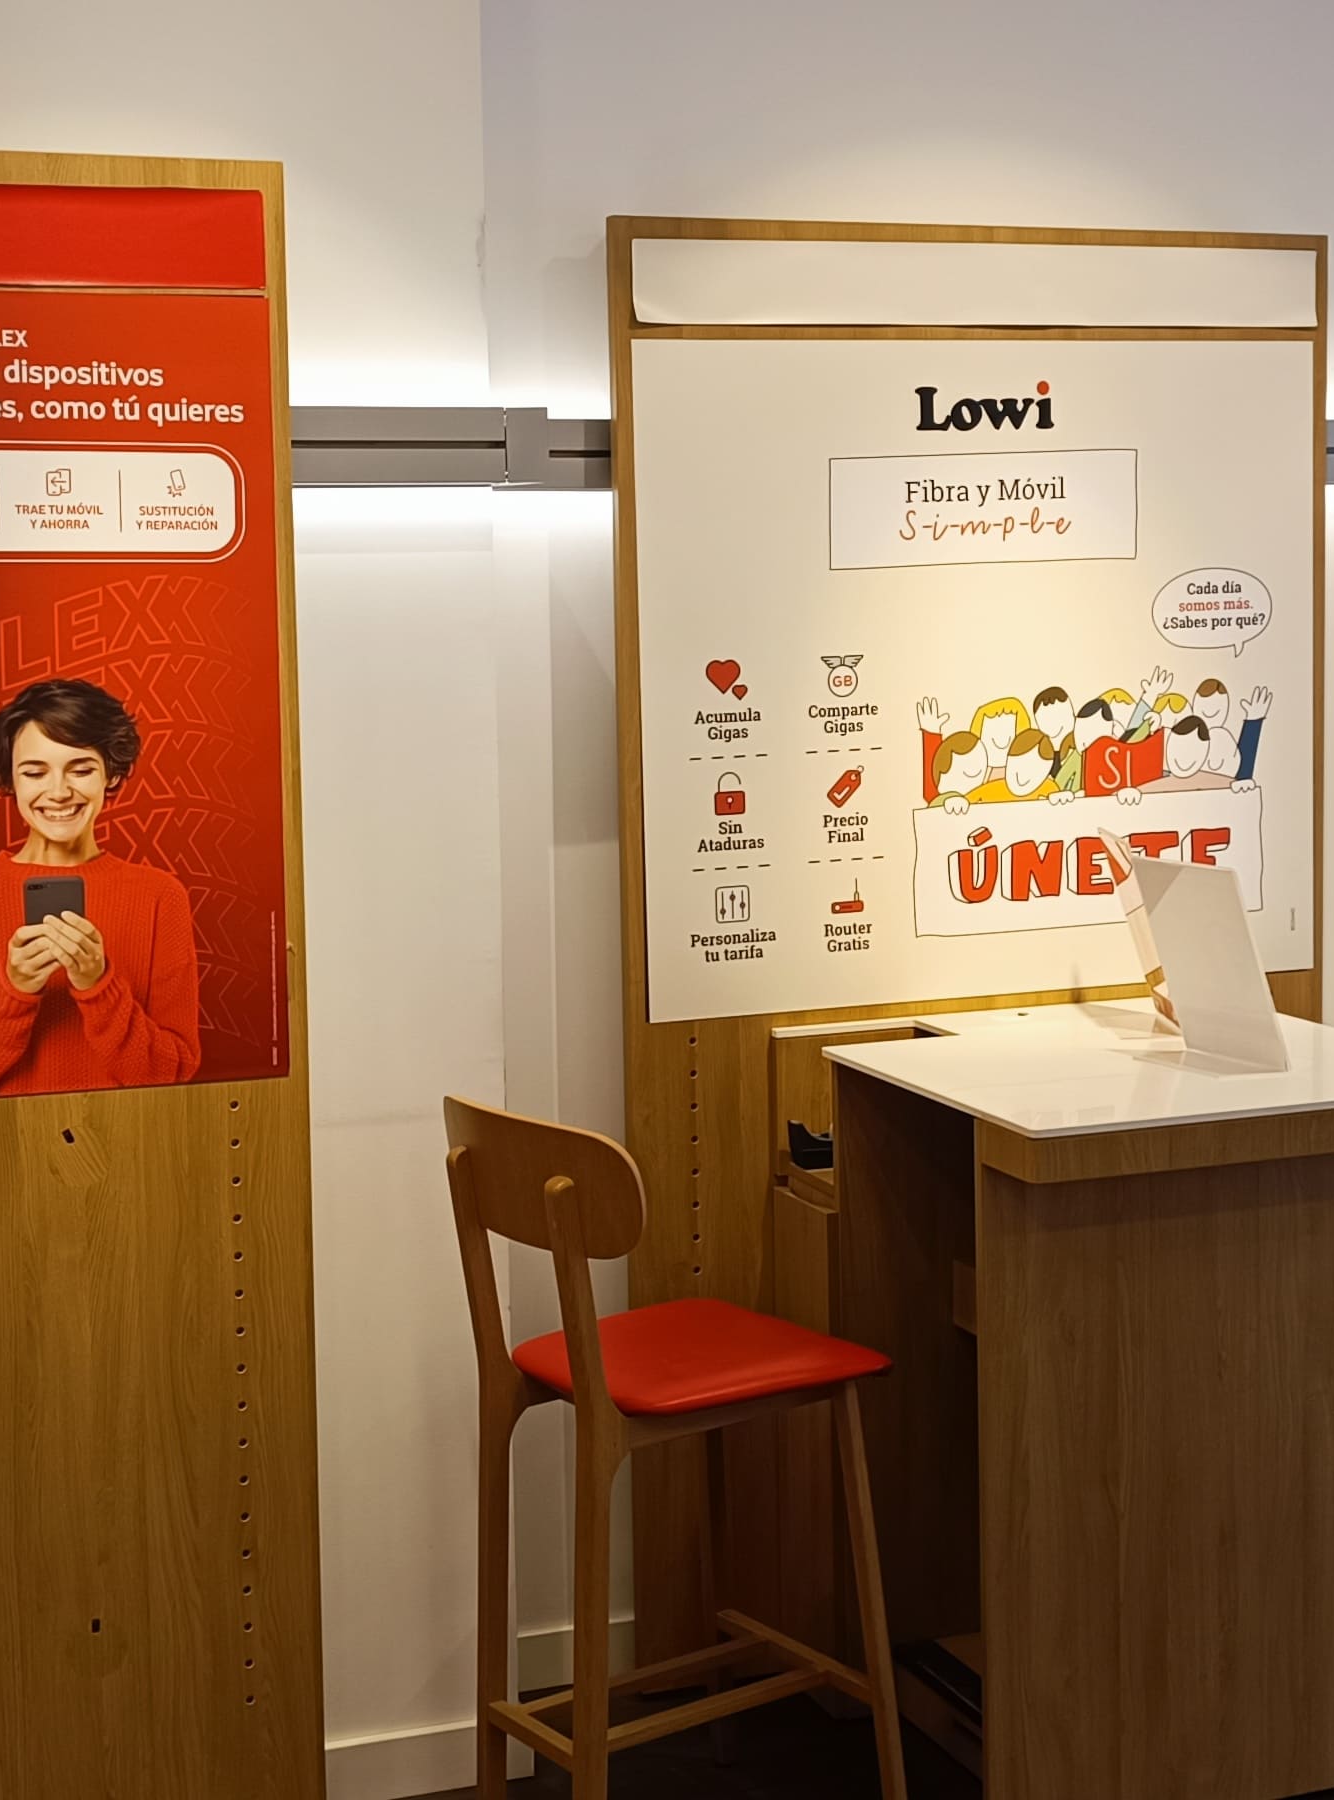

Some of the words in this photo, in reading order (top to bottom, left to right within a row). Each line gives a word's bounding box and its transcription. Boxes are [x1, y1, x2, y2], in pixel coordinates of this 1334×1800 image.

[3, 359, 164, 390] dispositivos
[30, 397, 106, 420] como
[112, 394, 140, 420] tú
[147, 396, 245, 427] quieres
[915, 380, 1055, 431] Lowi
[905, 479, 970, 504] Fibra
[977, 484, 991, 508] y
[997, 476, 1066, 502] Móvil
[15, 504, 46, 515] TRAE
[47, 504, 64, 515] TU
[66, 502, 104, 515] MÓVIL
[139, 504, 214, 516] SUSTITUCIÓN
[30, 518, 38, 529] Y
[39, 518, 90, 529] AHORRA
[136, 520, 144, 530] Y
[146, 518, 219, 531] REPARACIÓN
[899, 507, 1072, 542] S-i-m-p-l-e
[1186, 582, 1218, 595] Cada
[1222, 580, 1242, 594] día
[1178, 600, 1221, 612] somos
[1223, 597, 1254, 611] más.
[1162, 614, 1208, 631] ¿Sabes
[1211, 616, 1233, 631] por
[1235, 612, 1266, 630] qué?
[832, 675, 853, 687] GB
[694, 708, 761, 725] Acumula
[808, 703, 879, 720] Comparte
[707, 726, 749, 742] Gigas
[823, 720, 864, 736] Gigas
[718, 821, 743, 835] Sin
[823, 814, 869, 828] Precio
[827, 828, 865, 843] Final
[697, 836, 765, 853] Ataduras
[824, 923, 872, 937] Router
[690, 929, 777, 948] Personaliza
[827, 937, 870, 953] Gratis
[704, 948, 720, 963] tu
[724, 946, 764, 962] tarifa
